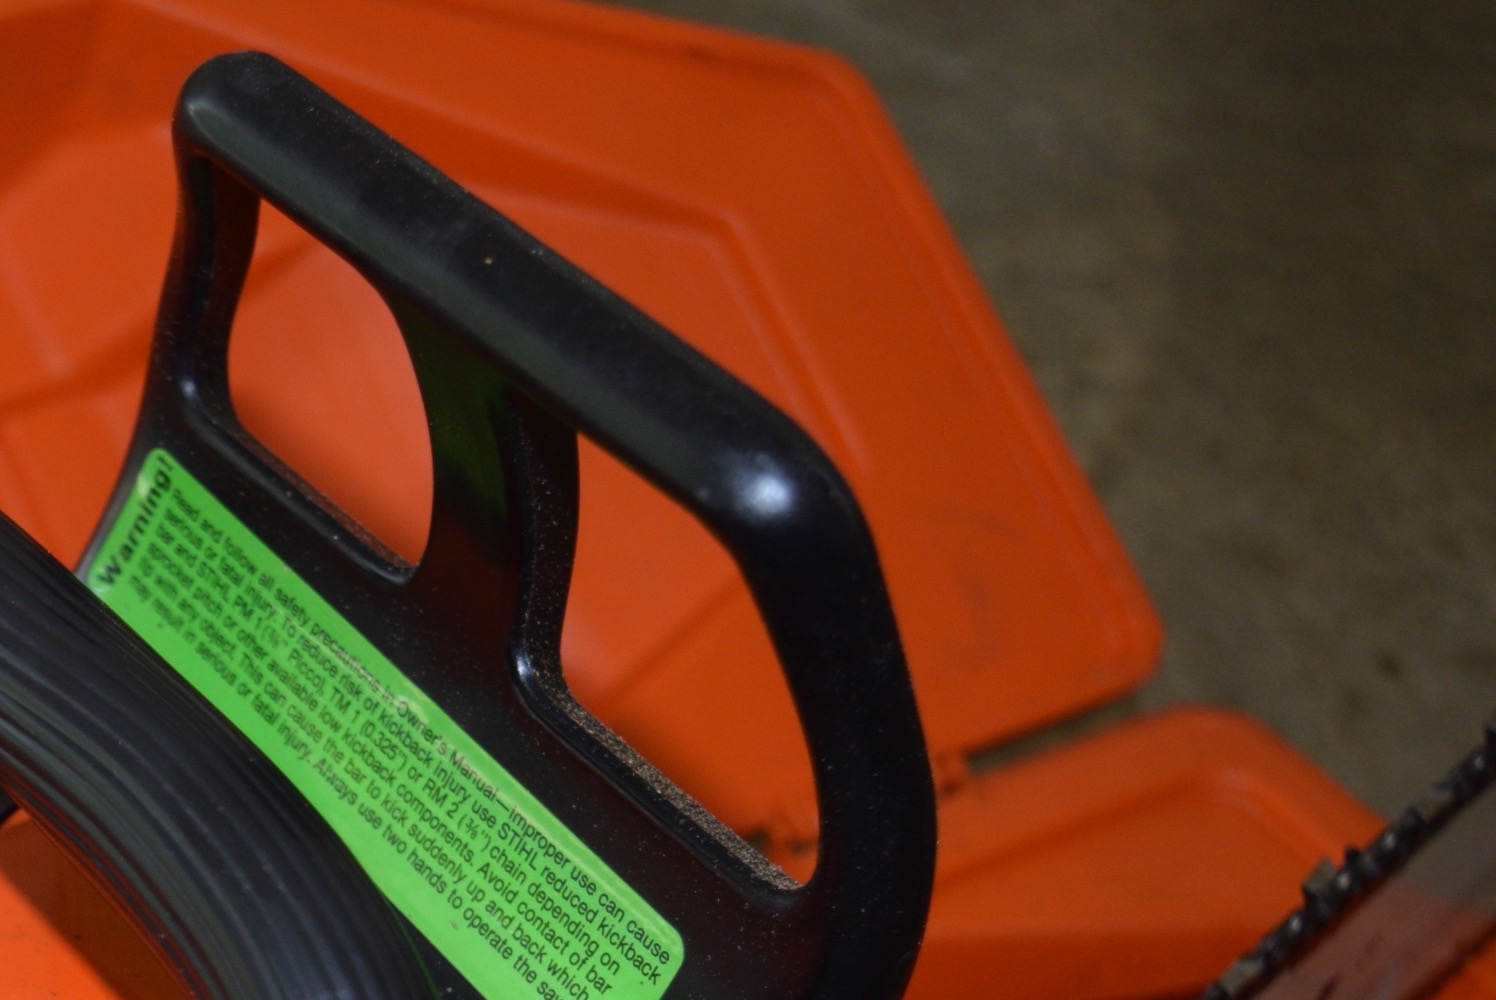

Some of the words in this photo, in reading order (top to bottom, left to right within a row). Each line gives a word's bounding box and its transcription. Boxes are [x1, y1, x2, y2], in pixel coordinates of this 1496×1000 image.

[97, 455, 174, 587] Warning!
[173, 541, 196, 568] and
[195, 561, 233, 602] STIHL
[327, 686, 351, 714] TM
[350, 709, 359, 723] 1
[406, 765, 421, 784] or
[422, 778, 447, 808] RM
[446, 802, 458, 818] 2
[488, 841, 529, 885] chain
[525, 878, 601, 958] depending
[599, 950, 621, 975] on
[200, 516, 222, 542] and
[222, 537, 258, 575] follow
[258, 570, 274, 591] all
[272, 585, 311, 628] safety
[309, 620, 382, 695] precautions
[569, 866, 597, 896] use
[597, 892, 626, 923] can
[625, 918, 670, 965] cause
[222, 614, 237, 633] or
[236, 626, 269, 663] other
[267, 656, 319, 711] available
[318, 706, 342, 734] low
[341, 727, 397, 787] kickback
[394, 780, 478, 868] components.
[477, 859, 518, 904] Avoid
[516, 897, 569, 954] contact
[568, 947, 587, 971] of
[586, 964, 613, 996] bar
[236, 680, 251, 700] or
[251, 693, 279, 725] fatal
[275, 719, 315, 765] injury.
[311, 755, 359, 808] Always
[358, 801, 383, 829] use
[382, 824, 408, 854] two
[407, 847, 449, 894] hands
[447, 889, 464, 910] to
[460, 904, 514, 963] operate
[513, 953, 539, 984] the
[237, 652, 265, 685] This
[264, 681, 285, 706] can
[286, 703, 323, 743] cause
[322, 736, 345, 764] the
[344, 757, 367, 785] bar
[366, 780, 382, 800] to
[381, 793, 409, 827] kick
[405, 820, 468, 887] suddenly
[464, 879, 486, 906] up
[485, 896, 514, 929] and
[512, 922, 548, 963] back
[279, 616, 298, 638] To
[297, 632, 339, 678] reduce
[339, 672, 363, 700] risk
[362, 695, 378, 715] of
[377, 709, 434, 767] kickback
[431, 762, 472, 806] injury
[470, 800, 497, 829] use
[496, 822, 542, 870] STIHL
[540, 863, 598, 924] reduced
[596, 917, 662, 985] kickback
